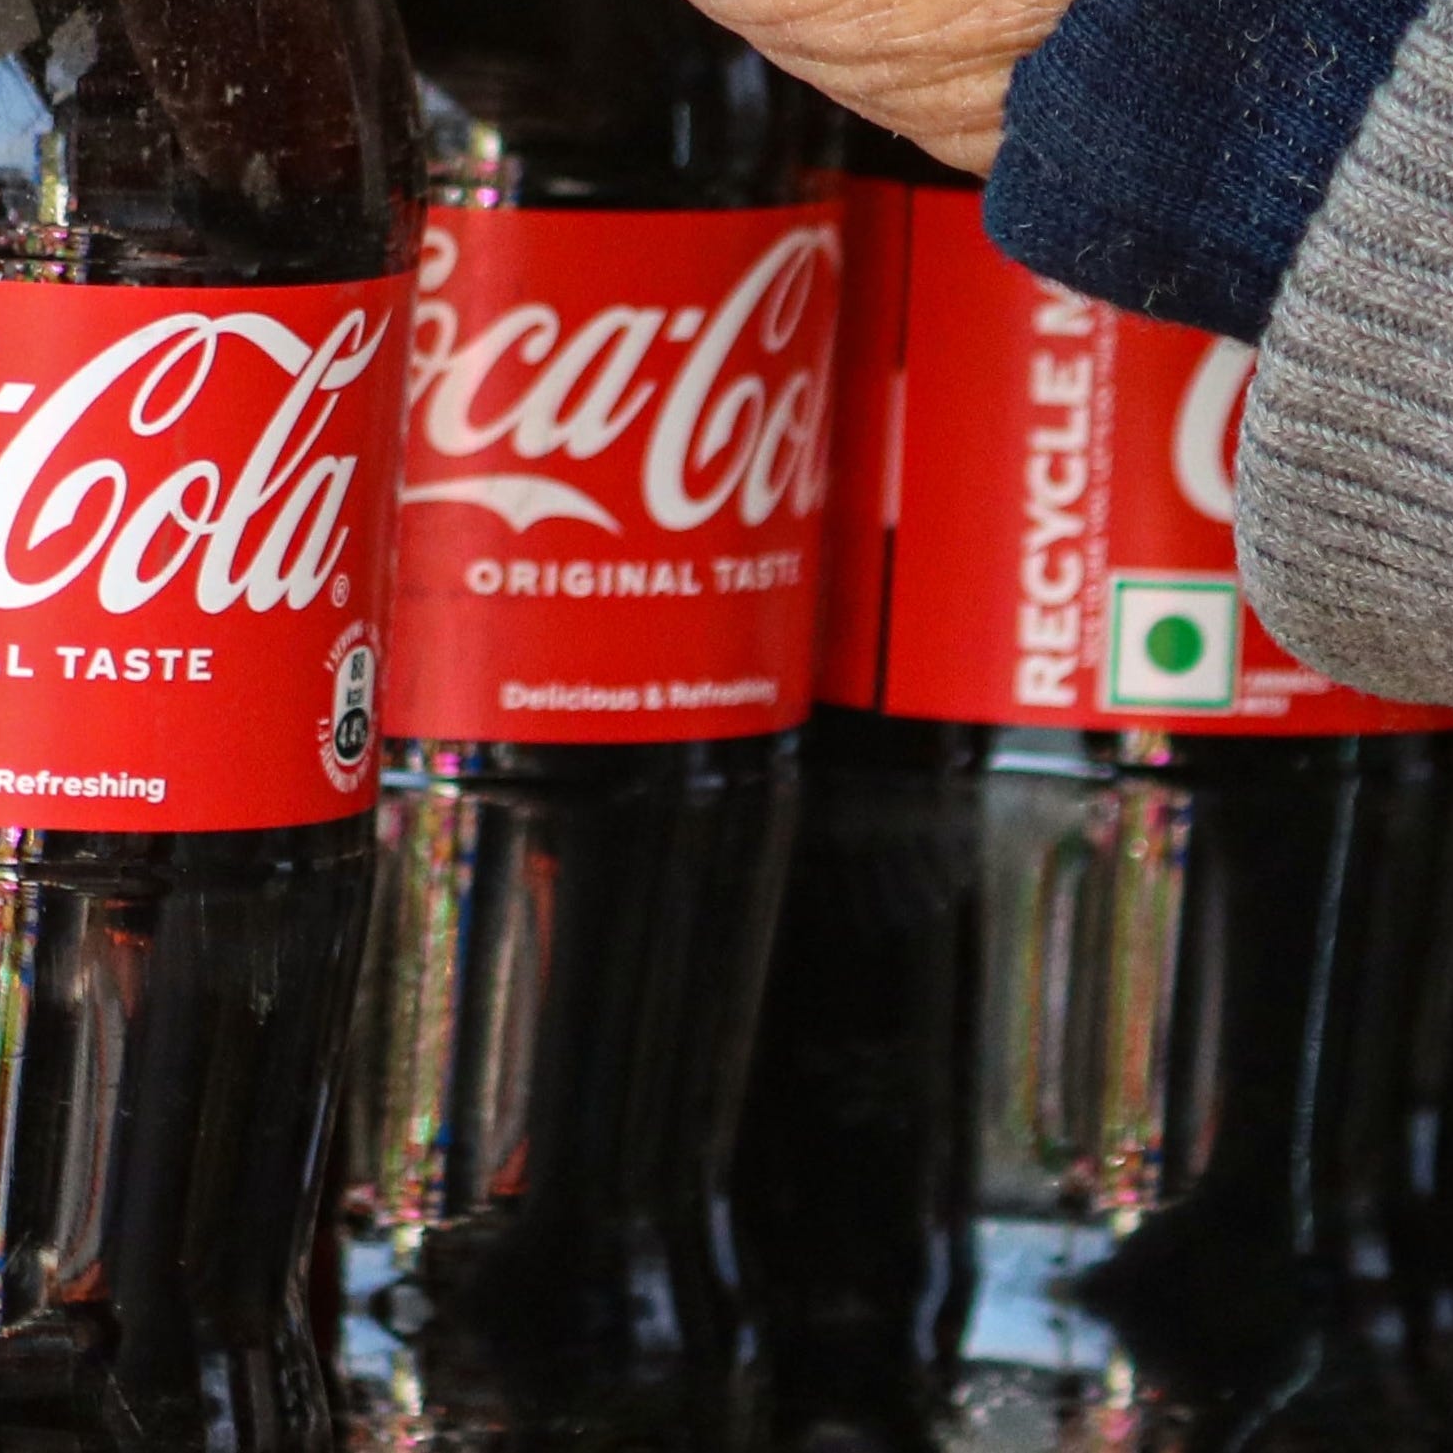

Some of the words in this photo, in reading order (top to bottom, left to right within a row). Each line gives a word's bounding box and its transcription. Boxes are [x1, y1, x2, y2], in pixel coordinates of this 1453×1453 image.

[1015, 355, 1094, 707] RECYCLE
[463, 558, 700, 597] ORIGINAL
[56, 646, 212, 681] TASTE
[501, 680, 640, 711] Delicious
